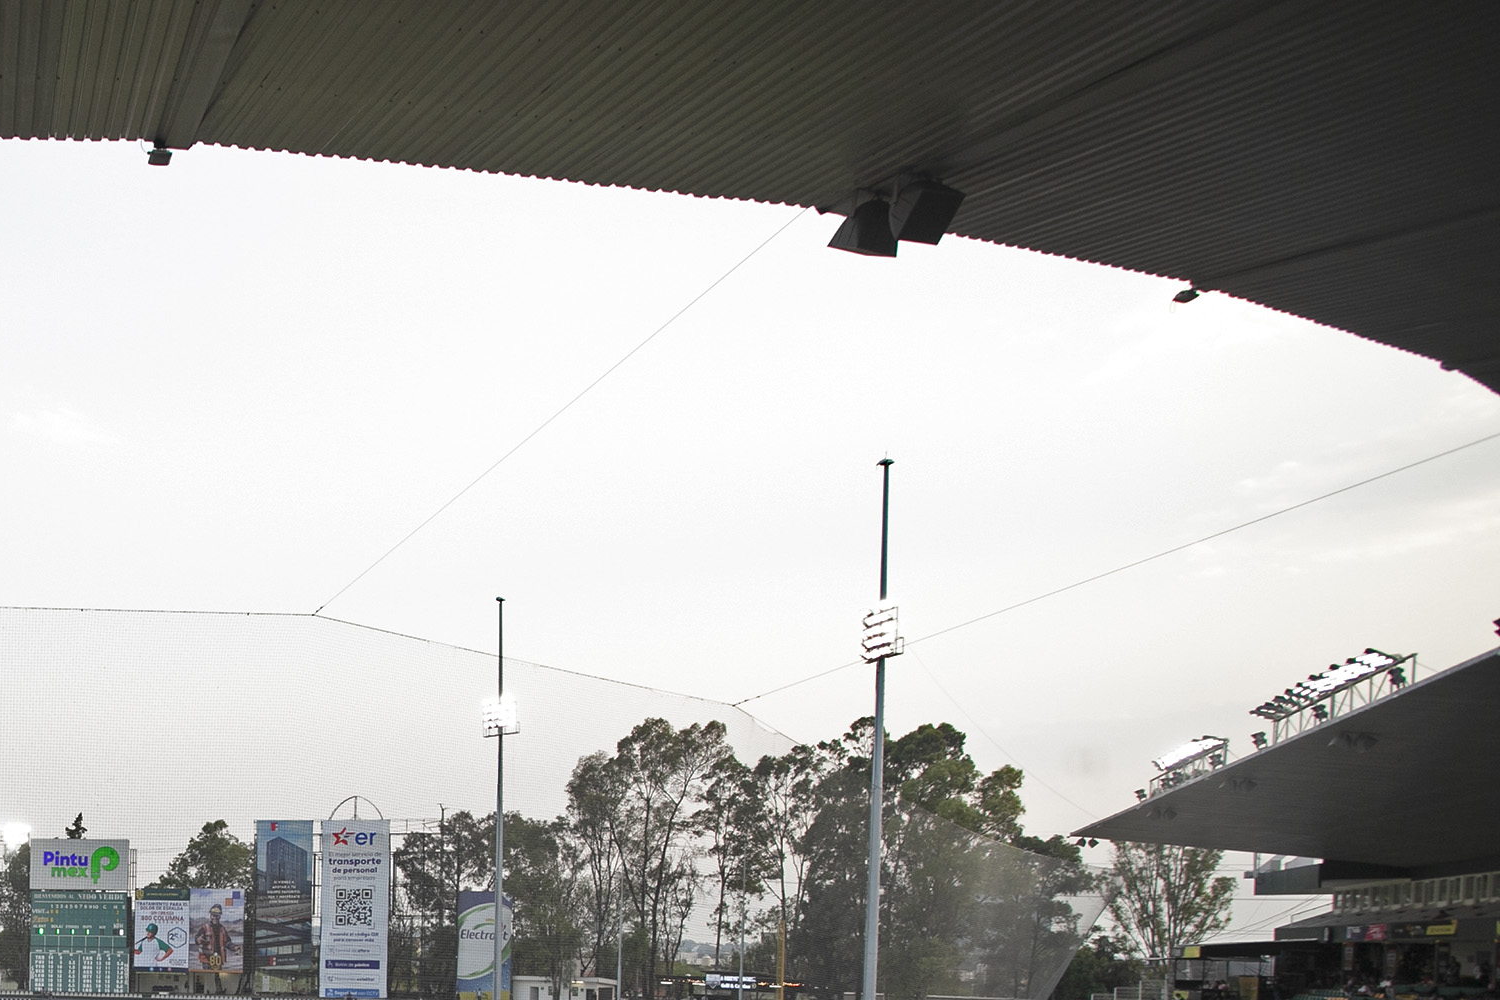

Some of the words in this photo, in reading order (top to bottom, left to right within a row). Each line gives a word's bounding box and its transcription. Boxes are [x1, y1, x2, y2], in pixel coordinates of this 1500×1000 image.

[355, 832, 376, 846] er
[44, 850, 88, 866] Pintu
[328, 858, 382, 867] transporte
[51, 866, 88, 878] mex
[343, 866, 378, 875] personal
[460, 928, 508, 940] Electrot
[209, 956, 221, 966] 80
